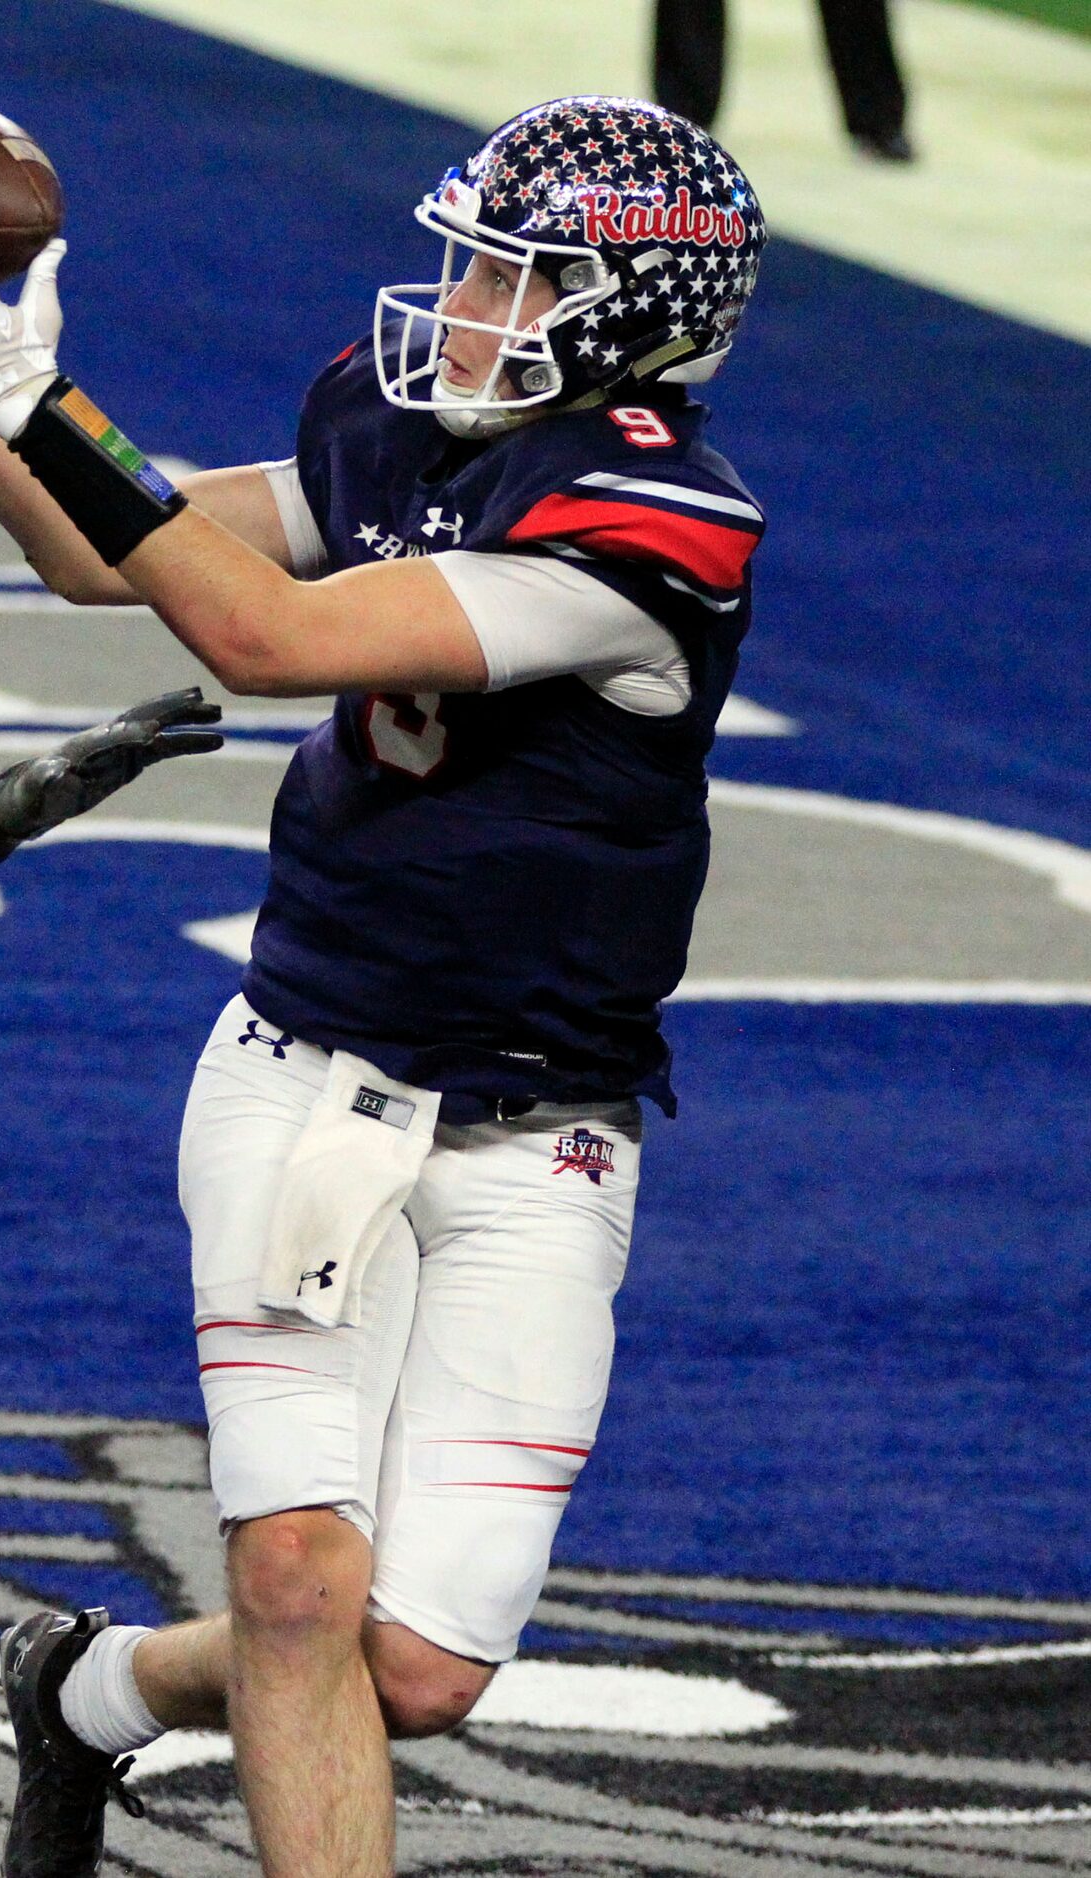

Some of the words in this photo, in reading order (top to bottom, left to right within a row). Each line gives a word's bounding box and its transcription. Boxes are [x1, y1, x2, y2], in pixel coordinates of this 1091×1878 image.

[578, 184, 746, 248] Raiders
[607, 407, 677, 448] 9
[560, 1137, 614, 1163] RYAN
